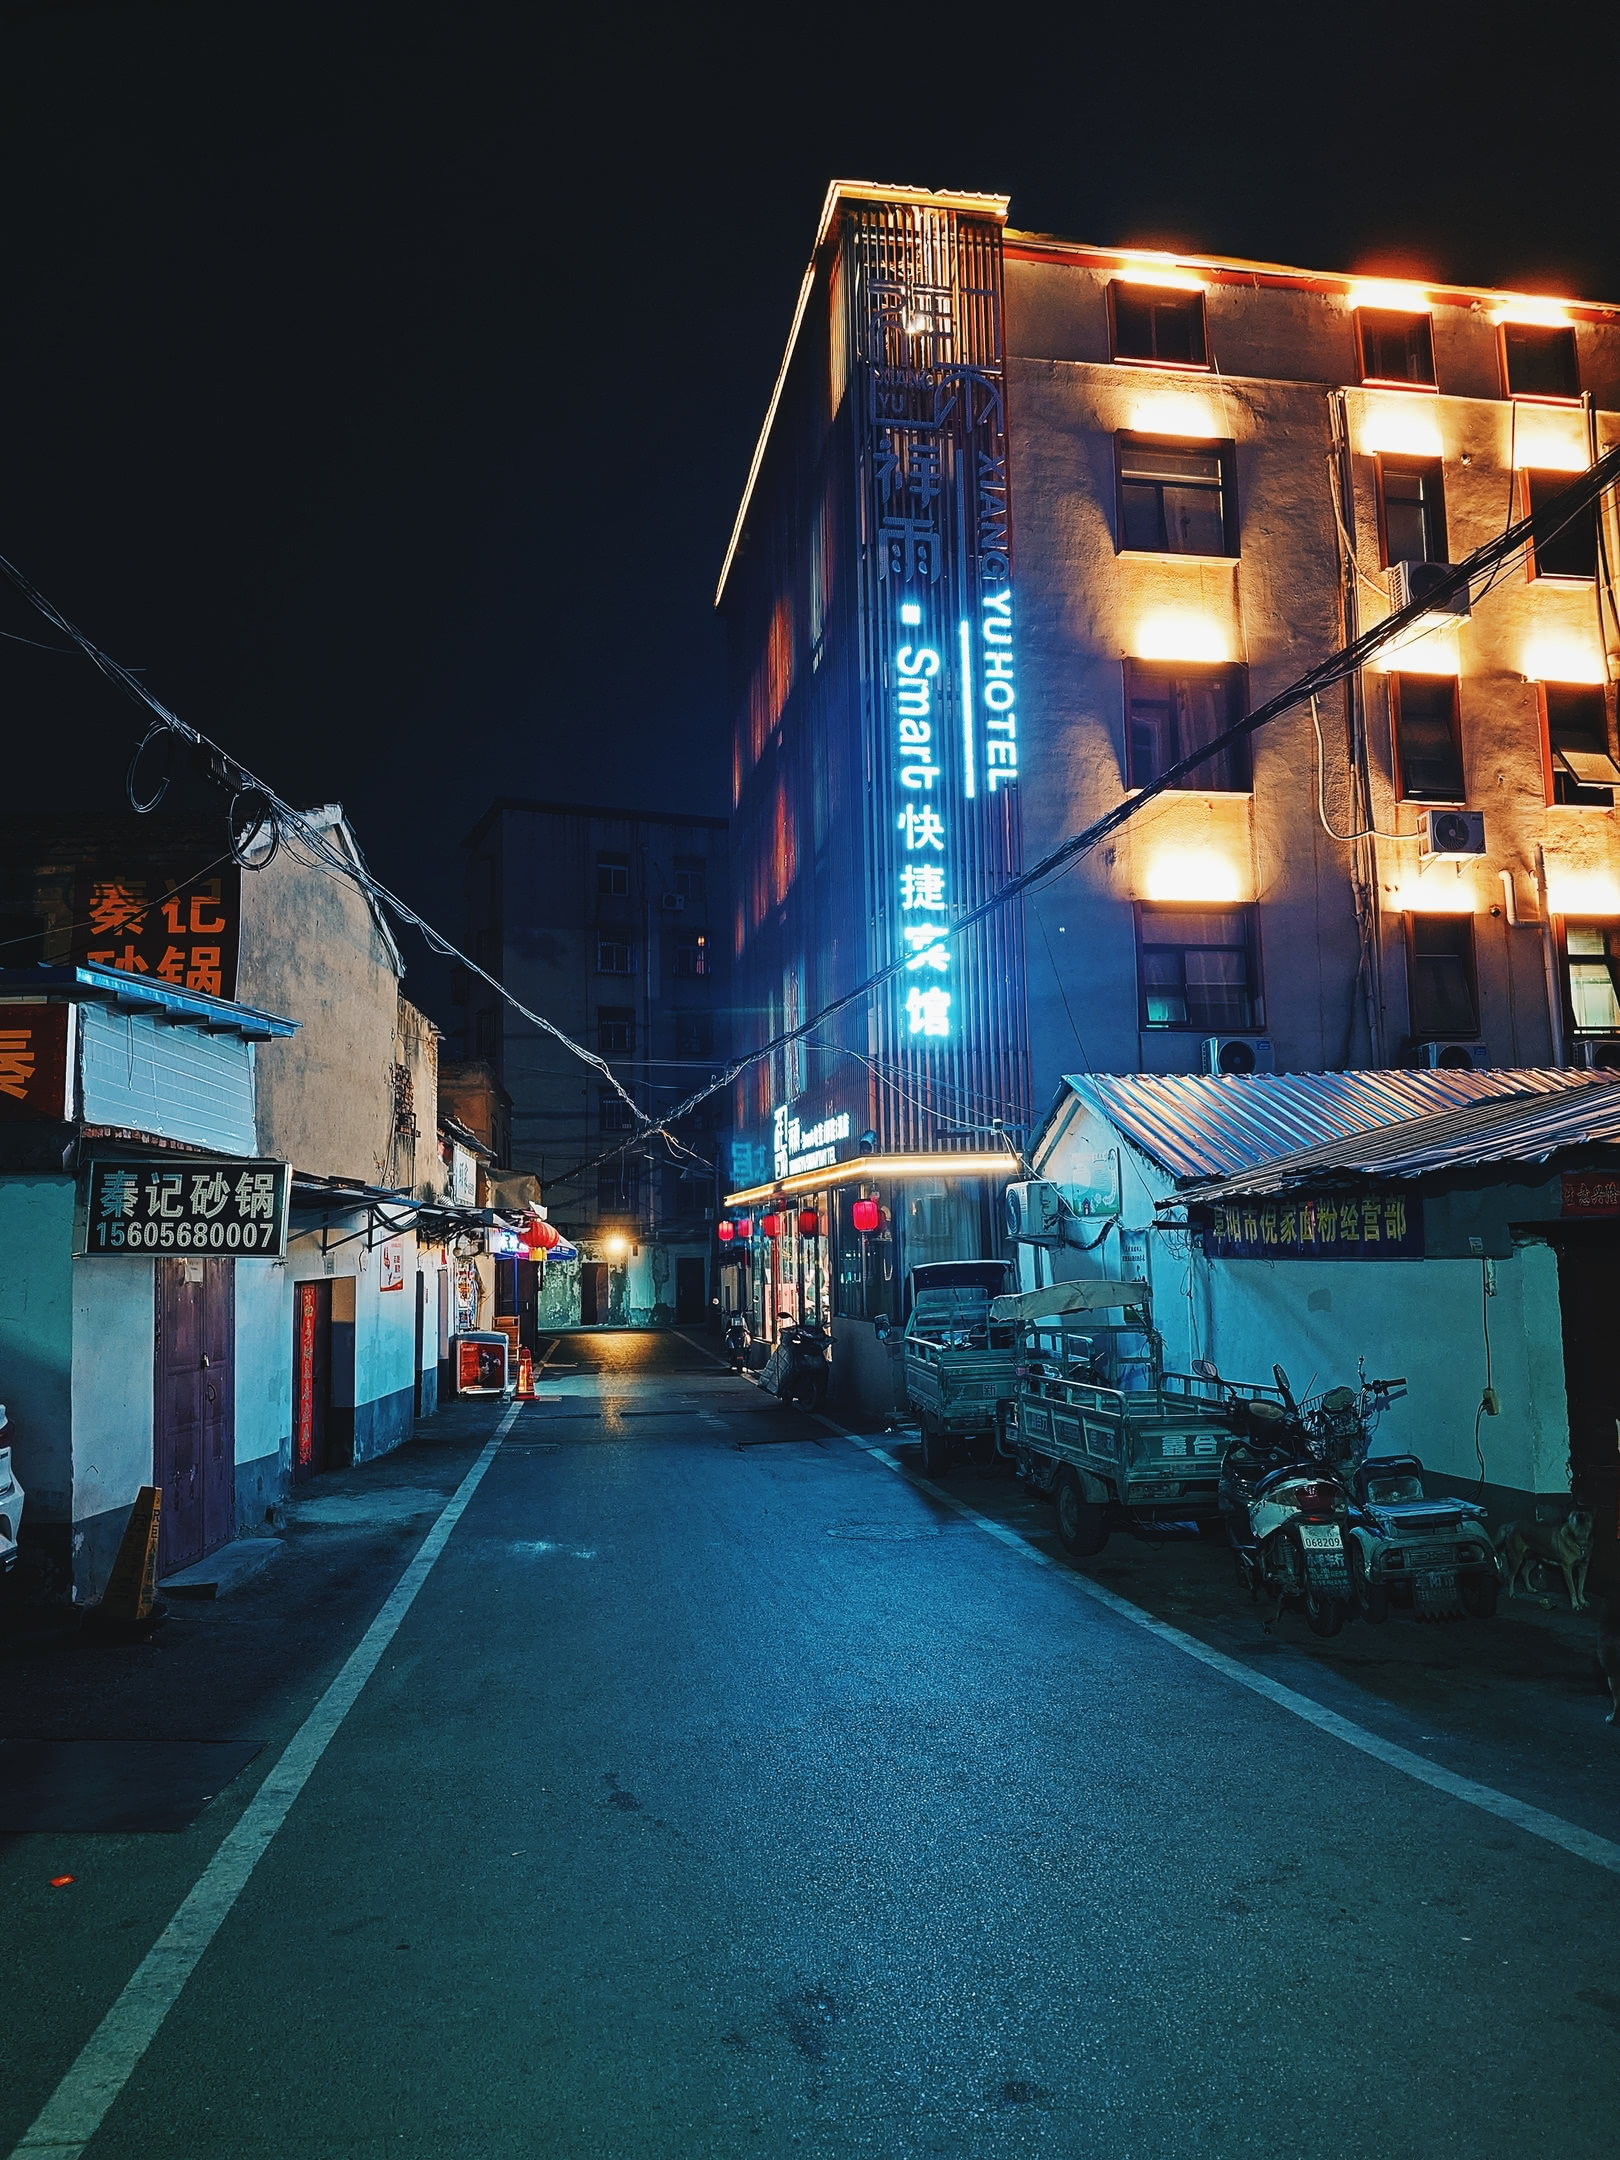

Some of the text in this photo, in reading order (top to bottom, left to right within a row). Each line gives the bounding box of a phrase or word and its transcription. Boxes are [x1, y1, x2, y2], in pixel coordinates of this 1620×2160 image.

[878, 393, 905, 414] YU
[977, 449, 1010, 582] XIANG
[897, 645, 941, 790] Smart
[88, 879, 227, 936] 秦记
[99, 1169, 276, 1220] 秦记砂锅
[96, 1221, 274, 1250] 15605680007
[1305, 1537, 1340, 1548] 068209
